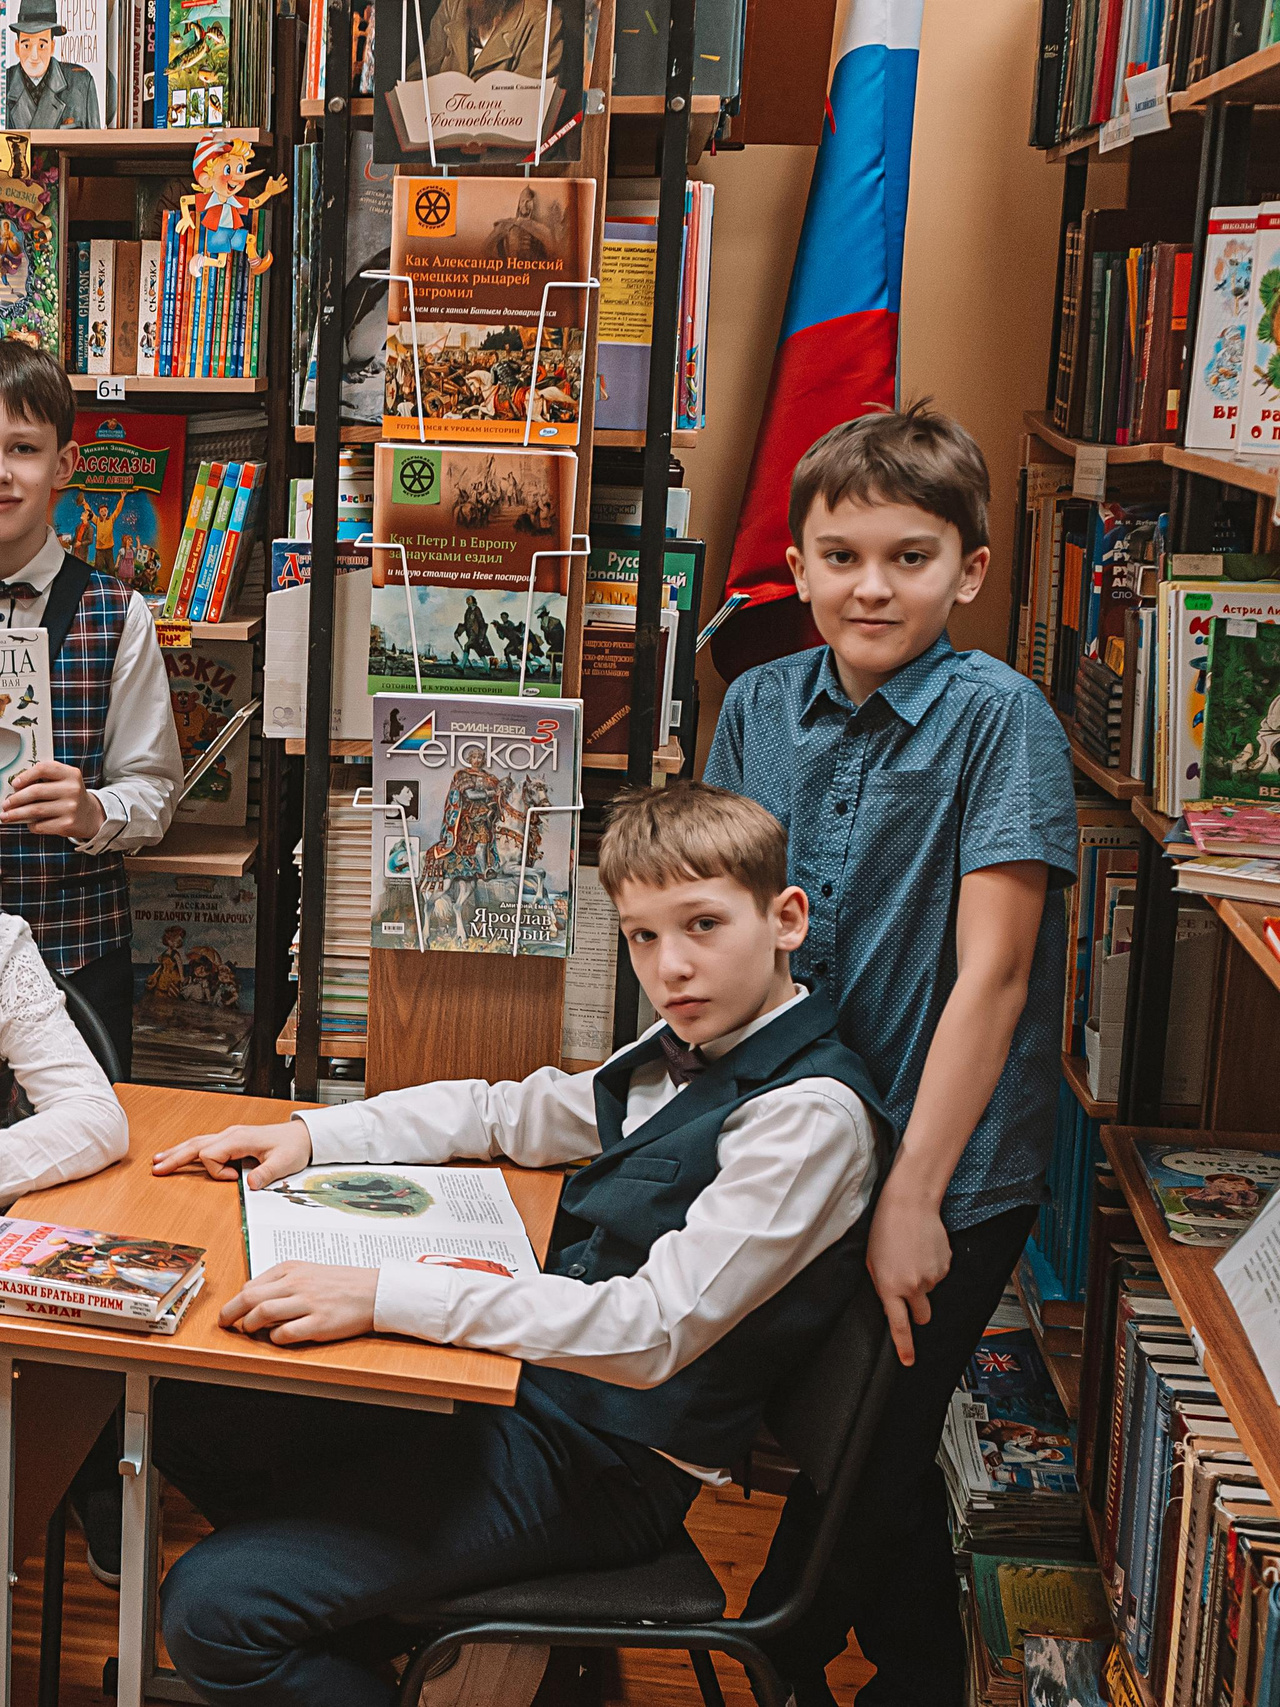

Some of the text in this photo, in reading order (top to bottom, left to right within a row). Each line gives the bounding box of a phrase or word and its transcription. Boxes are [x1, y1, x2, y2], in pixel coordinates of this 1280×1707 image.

[60, 34, 98, 63] КОРОЛЁВА
[445, 92, 503, 112] Помни
[424, 109, 523, 127] Достоевского
[405, 254, 564, 270] Как Александр Невский
[405, 271, 530, 287] немецких рыцарей
[78, 270, 90, 317] СКАЗОК
[404, 287, 473, 300] разгромил
[446, 307, 468, 315] ханом
[469, 307, 501, 316] Батыем
[98, 380, 122, 398] 6+
[451, 424, 480, 433] УРОКАМ
[75, 455, 156, 475] АССКАЗЫ
[85, 474, 134, 484] ДЛЯ ДЕТЕЙ
[390, 533, 517, 553] Как Петр I в Европу
[389, 551, 503, 564] за науками ездил
[423, 570, 460, 580] столицу
[472, 571, 493, 580] Неве
[1111, 591, 1132, 599] СЛО
[1222, 604, 1263, 615] Астрид
[591, 704, 632, 740] ГРАММАТИКА
[530, 719, 560, 744] 3
[386, 709, 558, 772] Детская
[175, 902, 218, 910] РАССКАЗЫ
[135, 910, 255, 924] ПРО БЕЛОЧКУ И ТАМАРОЧКУ
[469, 922, 551, 945] Мудрый
[1193, 1160, 1230, 1168] ЧТО
[1241, 1161, 1249, 1169] У
[25, 1225, 56, 1249] ГРИММ
[40, 1286, 85, 1304] БРАТЬЕВ
[87, 1295, 123, 1310] ГРИММ
[25, 1302, 81, 1318] ХАЙДИ
